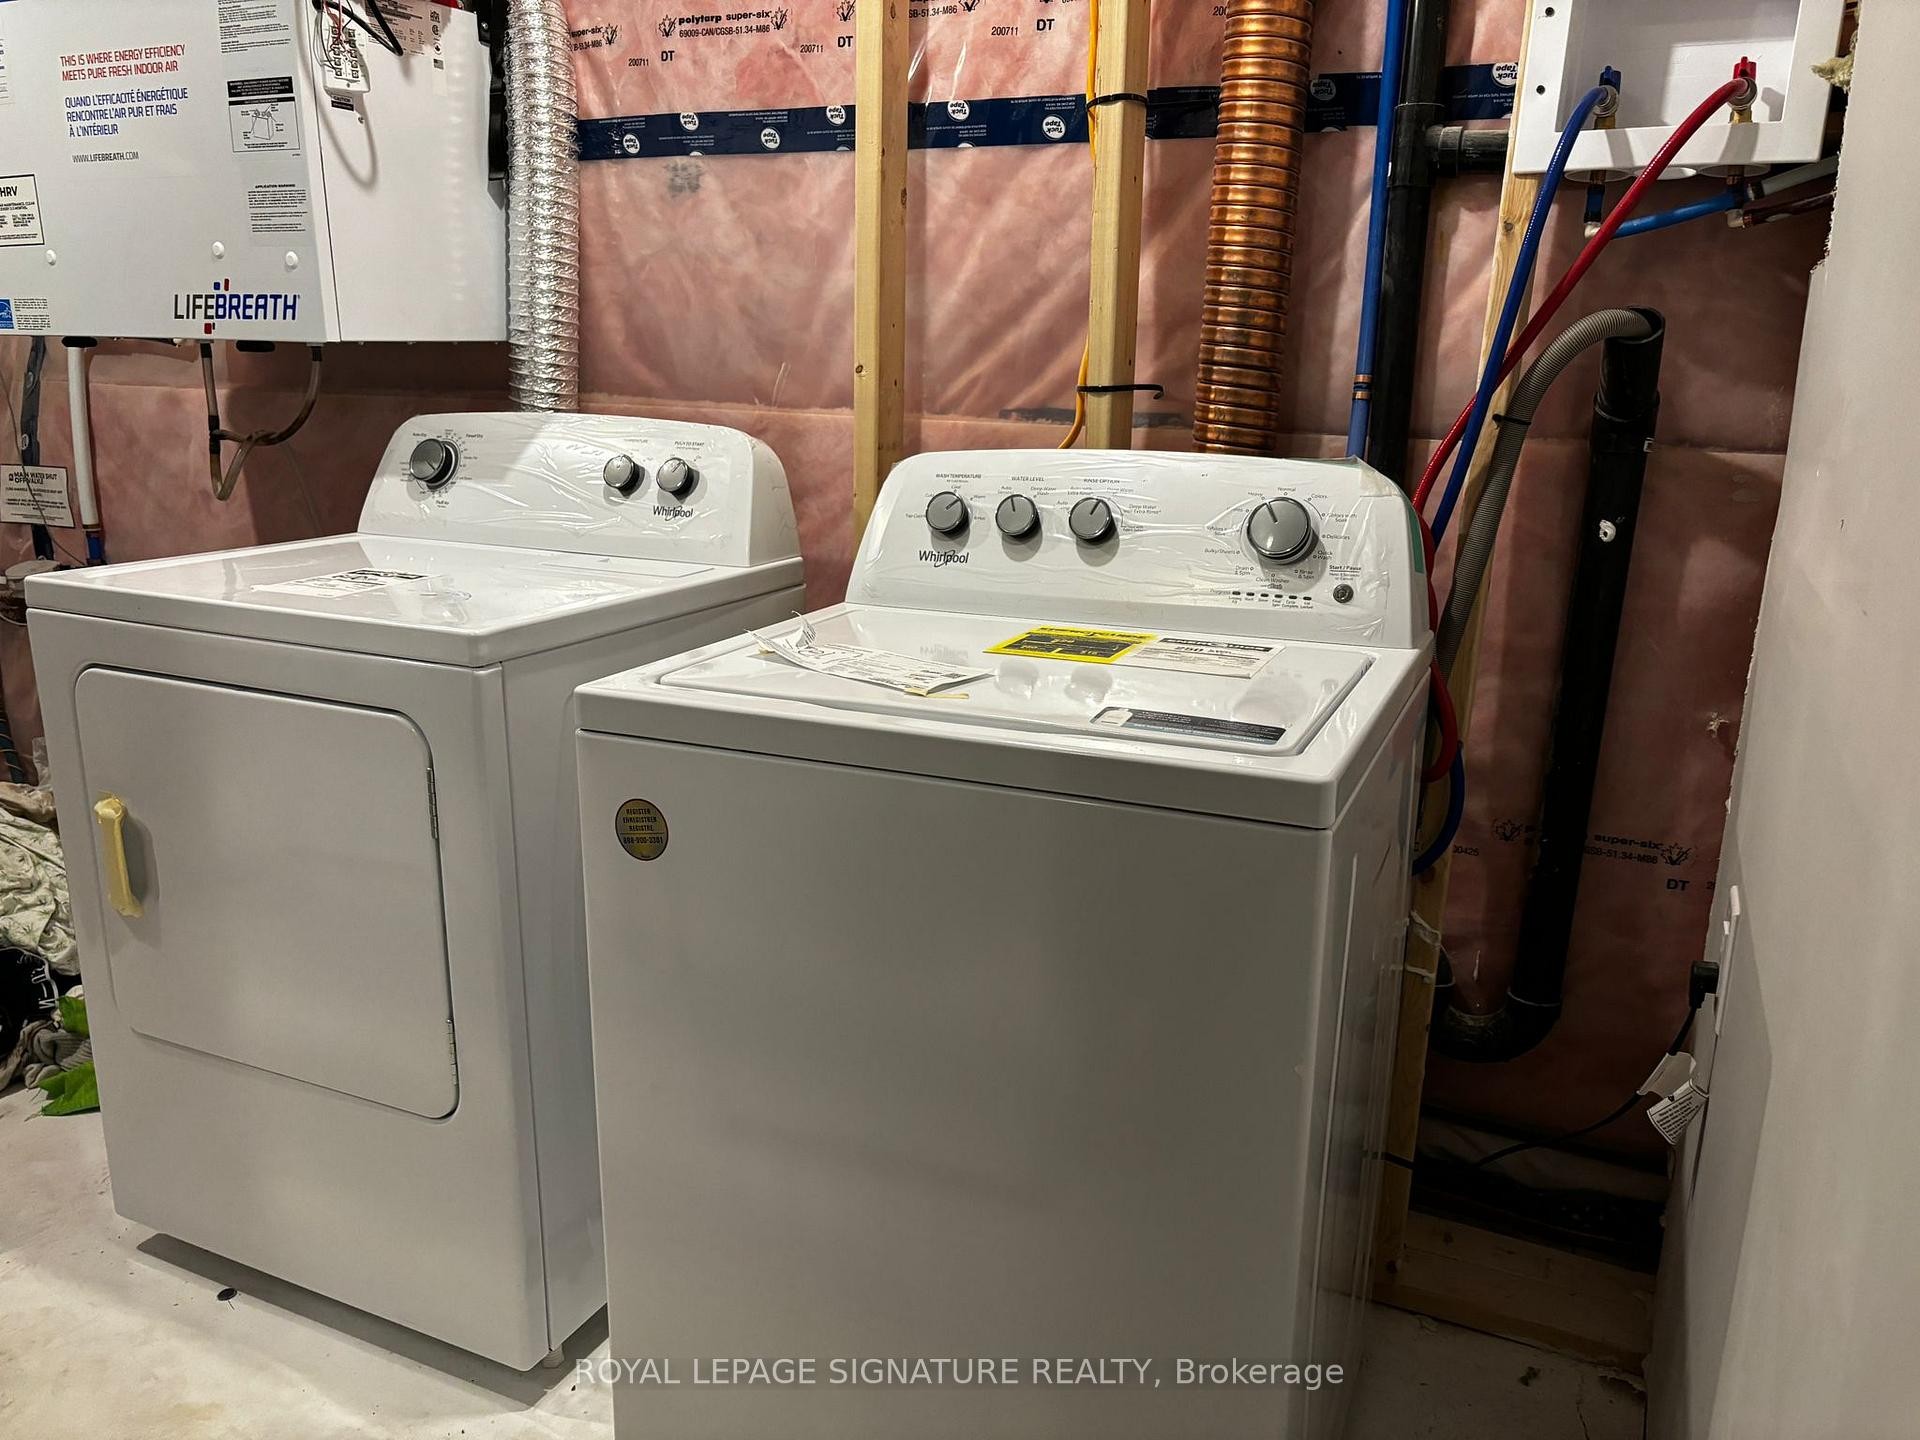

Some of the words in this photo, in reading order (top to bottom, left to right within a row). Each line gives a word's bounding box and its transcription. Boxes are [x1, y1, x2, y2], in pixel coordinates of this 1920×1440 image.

[678, 14, 722, 26] polytarp
[726, 10, 772, 22] super-six
[1036, 18, 1055, 32] DT
[679, 24, 770, 38] 69009-CAN/CGSB-51.34-M86
[991, 26, 1018, 36] 200711
[800, 44, 824, 54] 200711
[838, 36, 853, 48] DT
[60, 55, 76, 66] THIS
[78, 54, 85, 66] IS
[86, 52, 112, 65] WHERE
[114, 48, 143, 62] ENERGY
[144, 44, 186, 59] EFFICIENCY
[660, 50, 675, 62] DT
[628, 58, 650, 67] 200711
[62, 69, 86, 81] MEETS
[88, 67, 107, 79] PURE
[108, 64, 132, 77] FRESH
[134, 62, 164, 74] INDOOR
[165, 60, 178, 72] AIR
[65, 96, 91, 108] QUAND
[93, 90, 135, 106] L'EFFICACITÉ
[136, 86, 188, 102] ÉNERGÉTIQUE
[66, 108, 108, 122] RENCONTRE
[109, 108, 126, 119] L'AIR
[128, 106, 144, 118] PUR
[145, 106, 154, 116] ET
[156, 104, 178, 116] FRAIS
[69, 124, 76, 138] À
[76, 122, 118, 137] L'INTÉRIEUR
[72, 151, 140, 163] WWW.LIFEBREATH.COM
[174, 294, 296, 320] LIFEBREATH
[653, 506, 694, 521] Whirlpool
[919, 550, 970, 568] Whirlpool
[1666, 878, 1690, 891] DT
